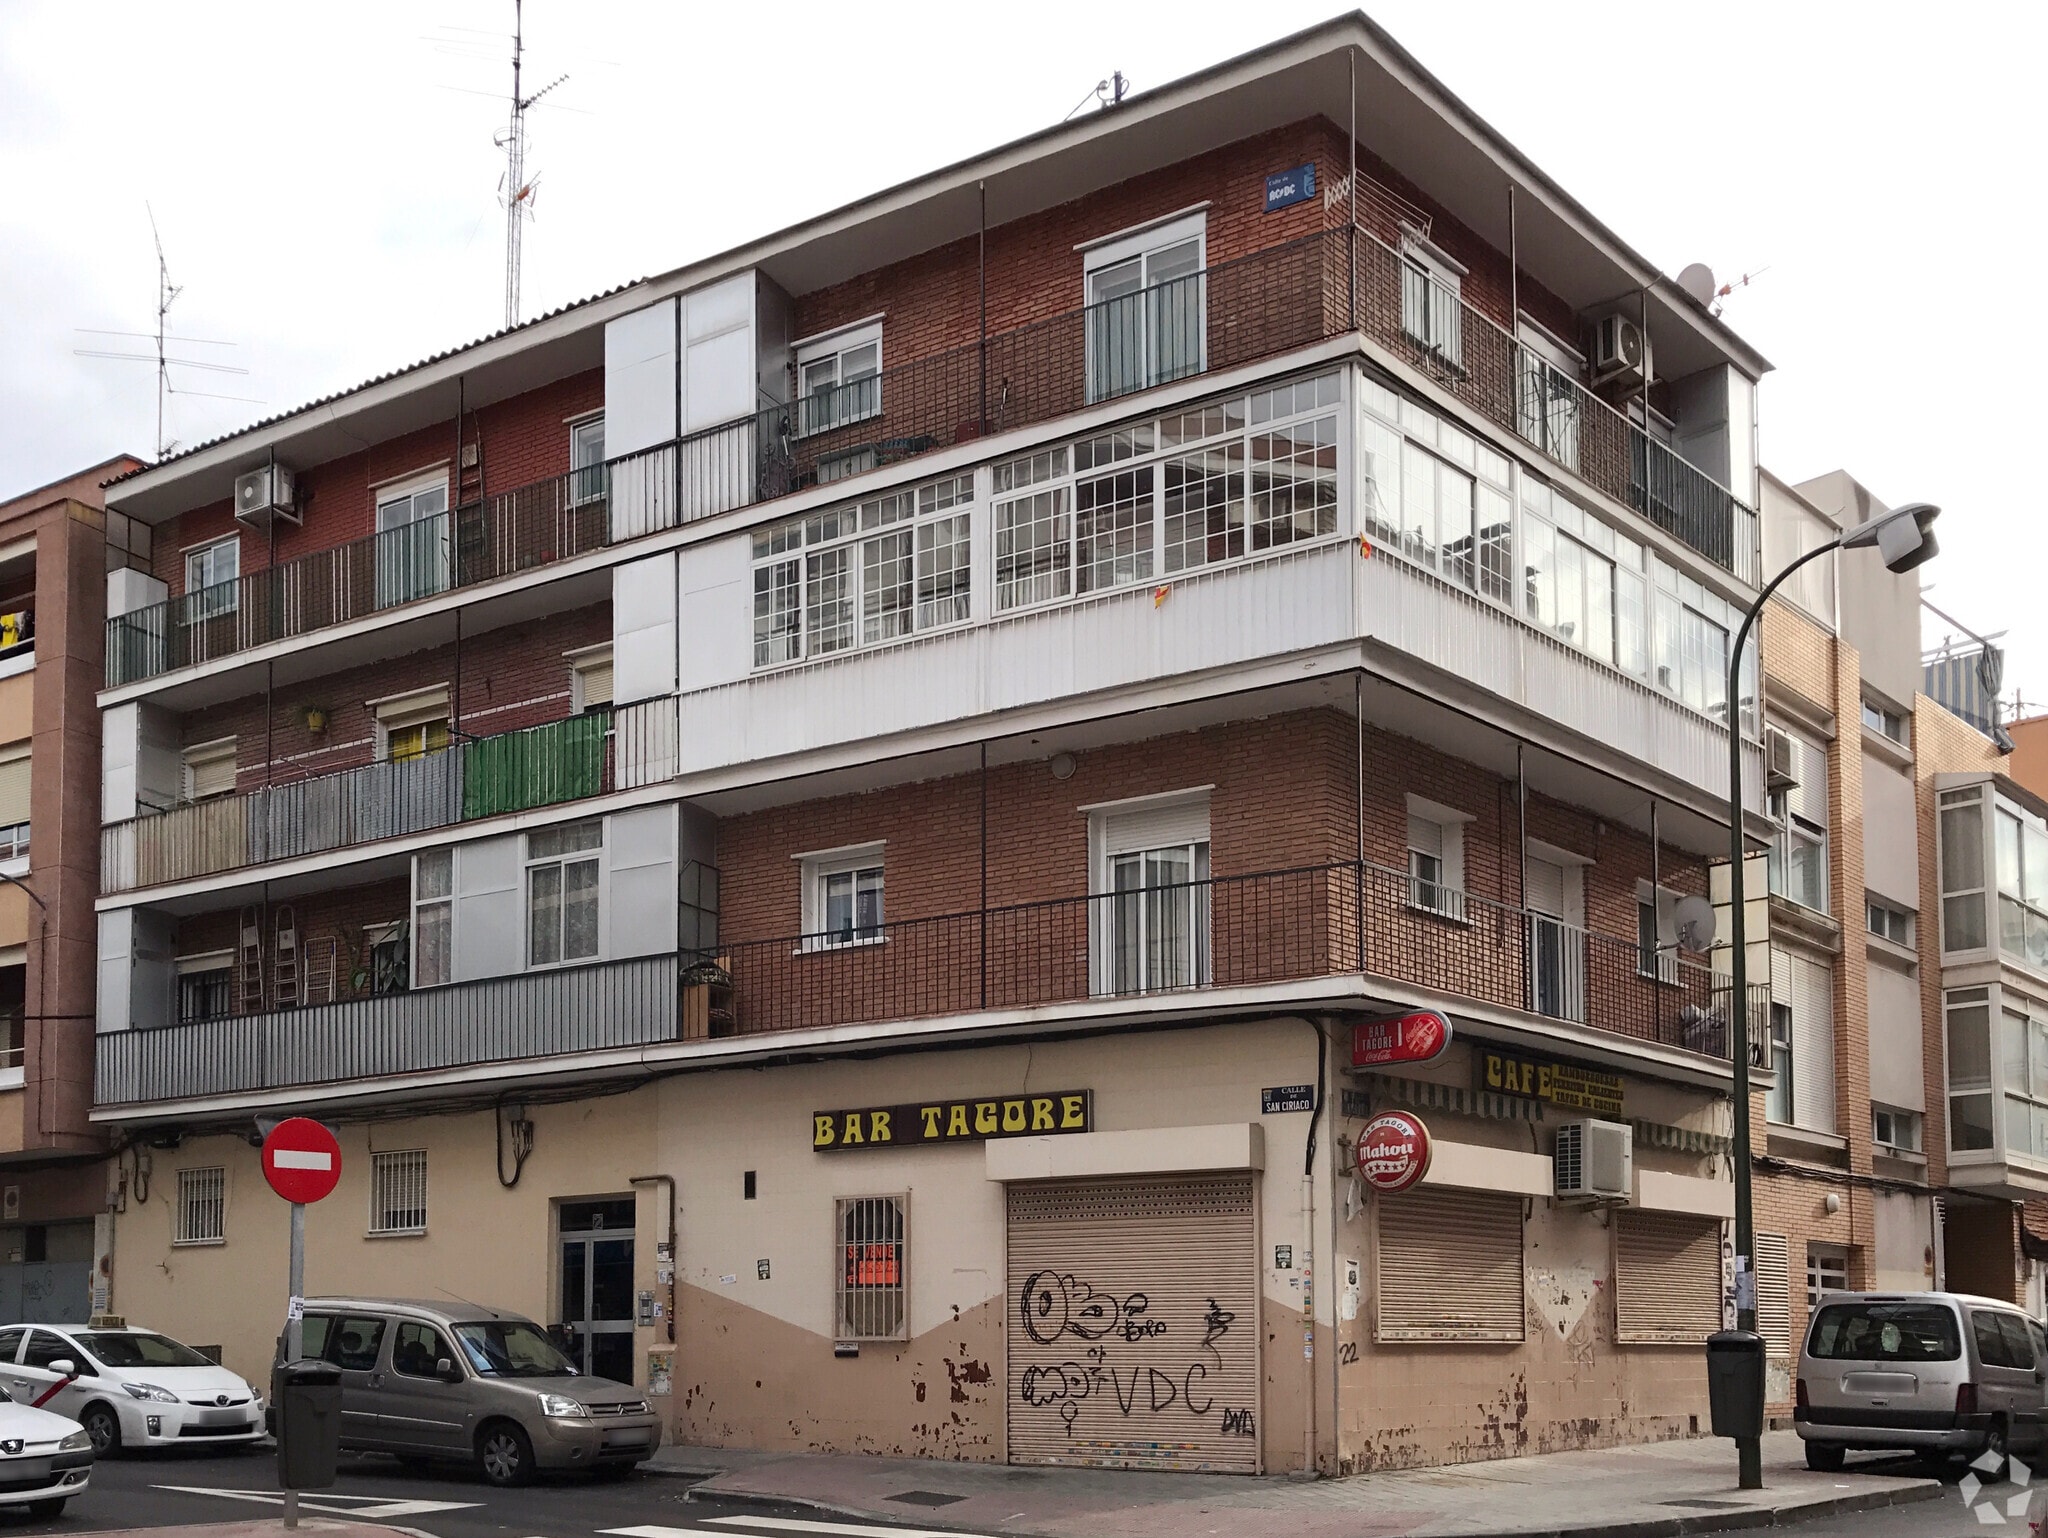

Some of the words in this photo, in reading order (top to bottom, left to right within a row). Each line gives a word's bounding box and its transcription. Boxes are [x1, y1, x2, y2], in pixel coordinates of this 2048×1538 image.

[1368, 1024, 1385, 1038] BAR
[1362, 1035, 1393, 1051] TAGORE
[1486, 1054, 1552, 1097] CAFE
[1281, 1086, 1306, 1094] CALLE
[1266, 1101, 1281, 1112] SAN
[1281, 1099, 1310, 1111] CIRIACO
[1555, 1090, 1580, 1105] TAPAS
[1581, 1096, 1592, 1107] DE
[1593, 1098, 1622, 1113] COCINA
[814, 1111, 892, 1146] BAR
[921, 1095, 1084, 1138] TAGORE
[1379, 1119, 1412, 1140] TAGORE
[1360, 1142, 1415, 1161] Mahou
[1339, 1342, 1360, 1366] 22
